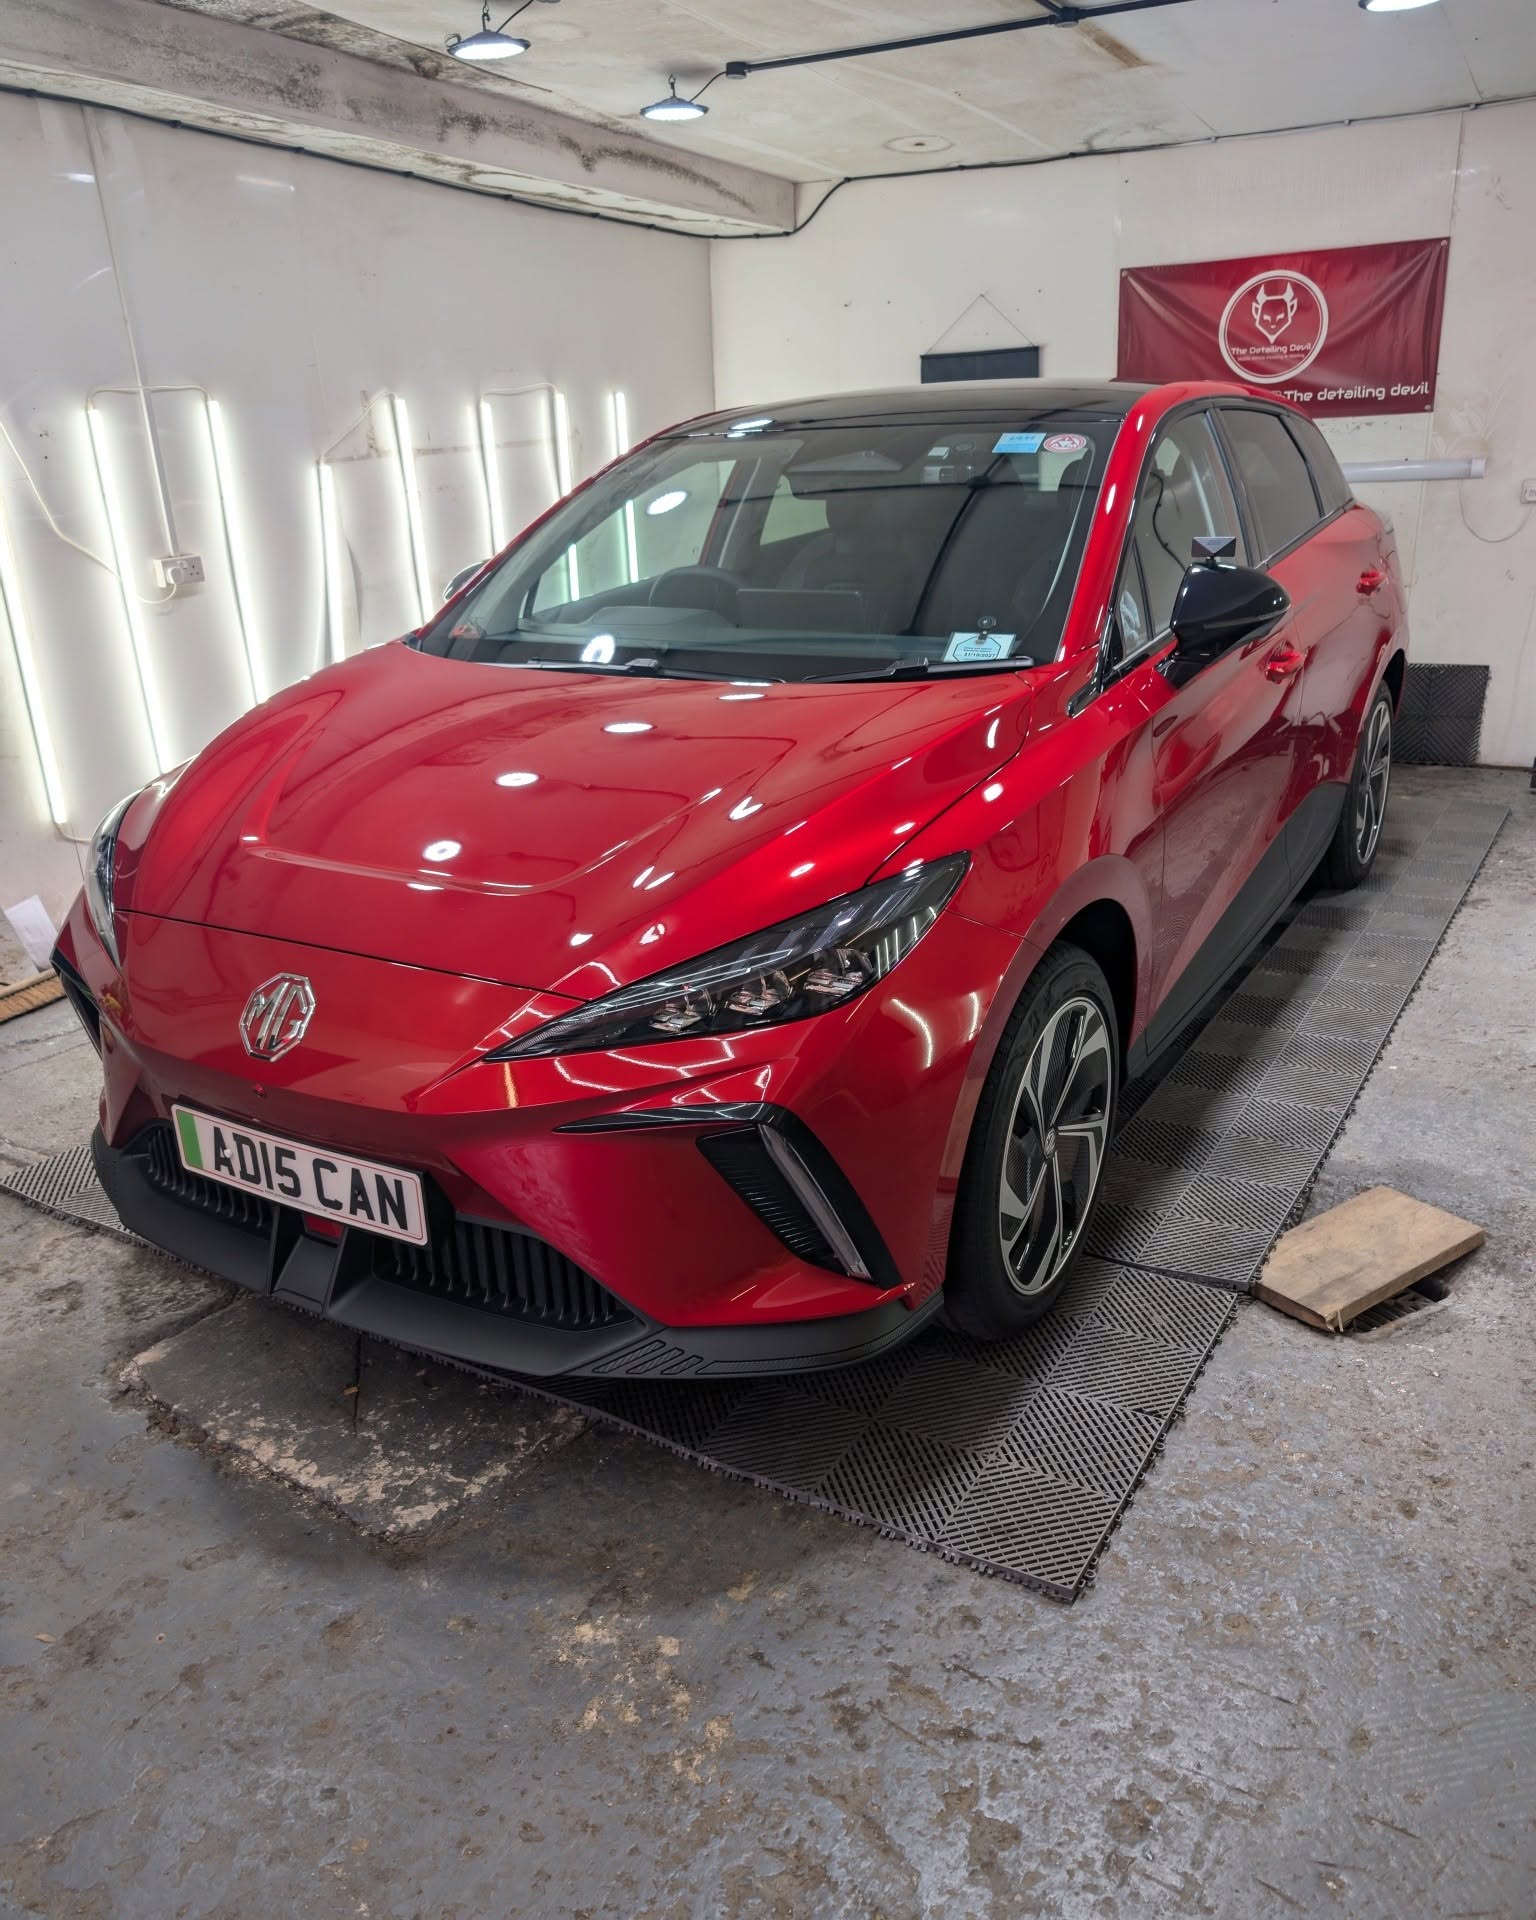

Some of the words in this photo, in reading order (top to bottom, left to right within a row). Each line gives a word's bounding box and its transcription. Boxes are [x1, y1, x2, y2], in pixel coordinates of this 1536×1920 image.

[1231, 347, 1248, 355] The
[1249, 344, 1288, 354] Detailing
[1289, 342, 1312, 352] Devil
[1317, 386, 1386, 400] detailing
[1390, 382, 1429, 396] devil
[247, 981, 308, 1052] MG
[213, 1126, 302, 1199] AD15
[312, 1157, 408, 1231] CAN
